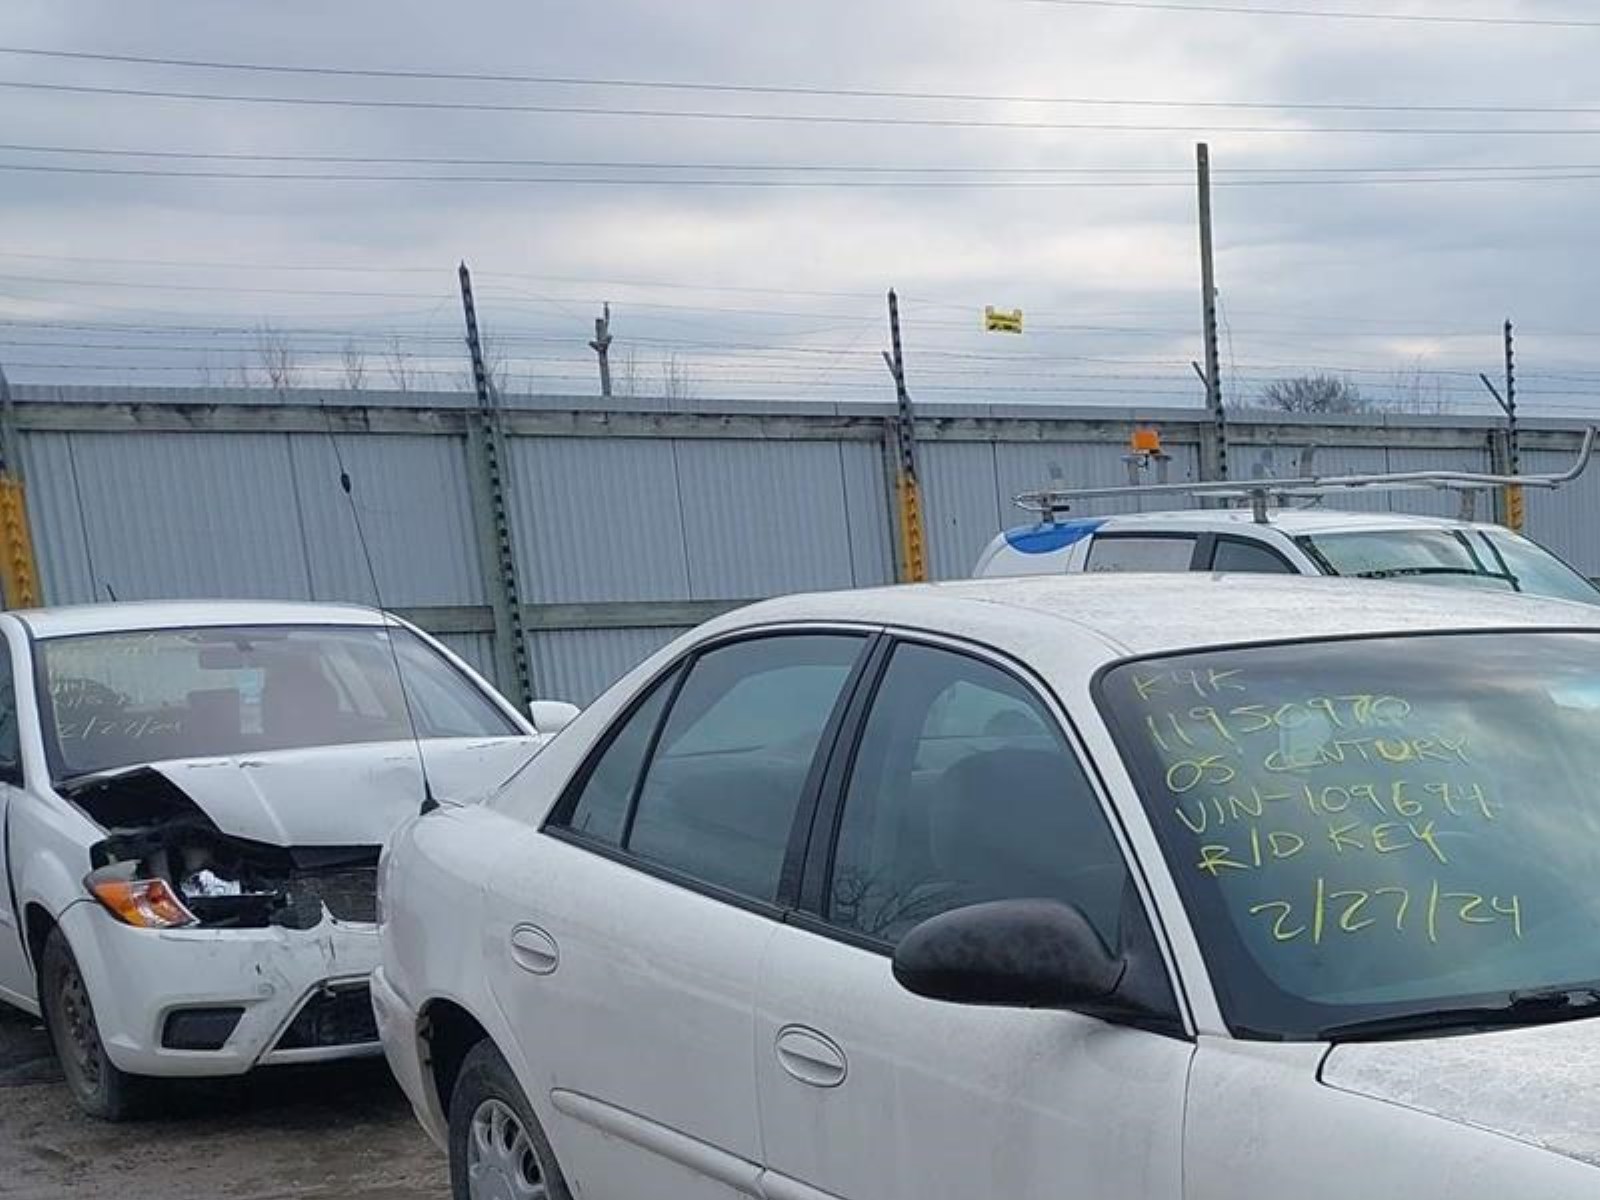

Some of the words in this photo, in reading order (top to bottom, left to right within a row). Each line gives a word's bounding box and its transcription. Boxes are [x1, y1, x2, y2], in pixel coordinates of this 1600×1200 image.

[1146, 693, 1412, 751] 11950970
[1263, 731, 1473, 774] CENTURY
[1328, 820, 1448, 864] KEY
[1249, 877, 1523, 944] 2/27/24
